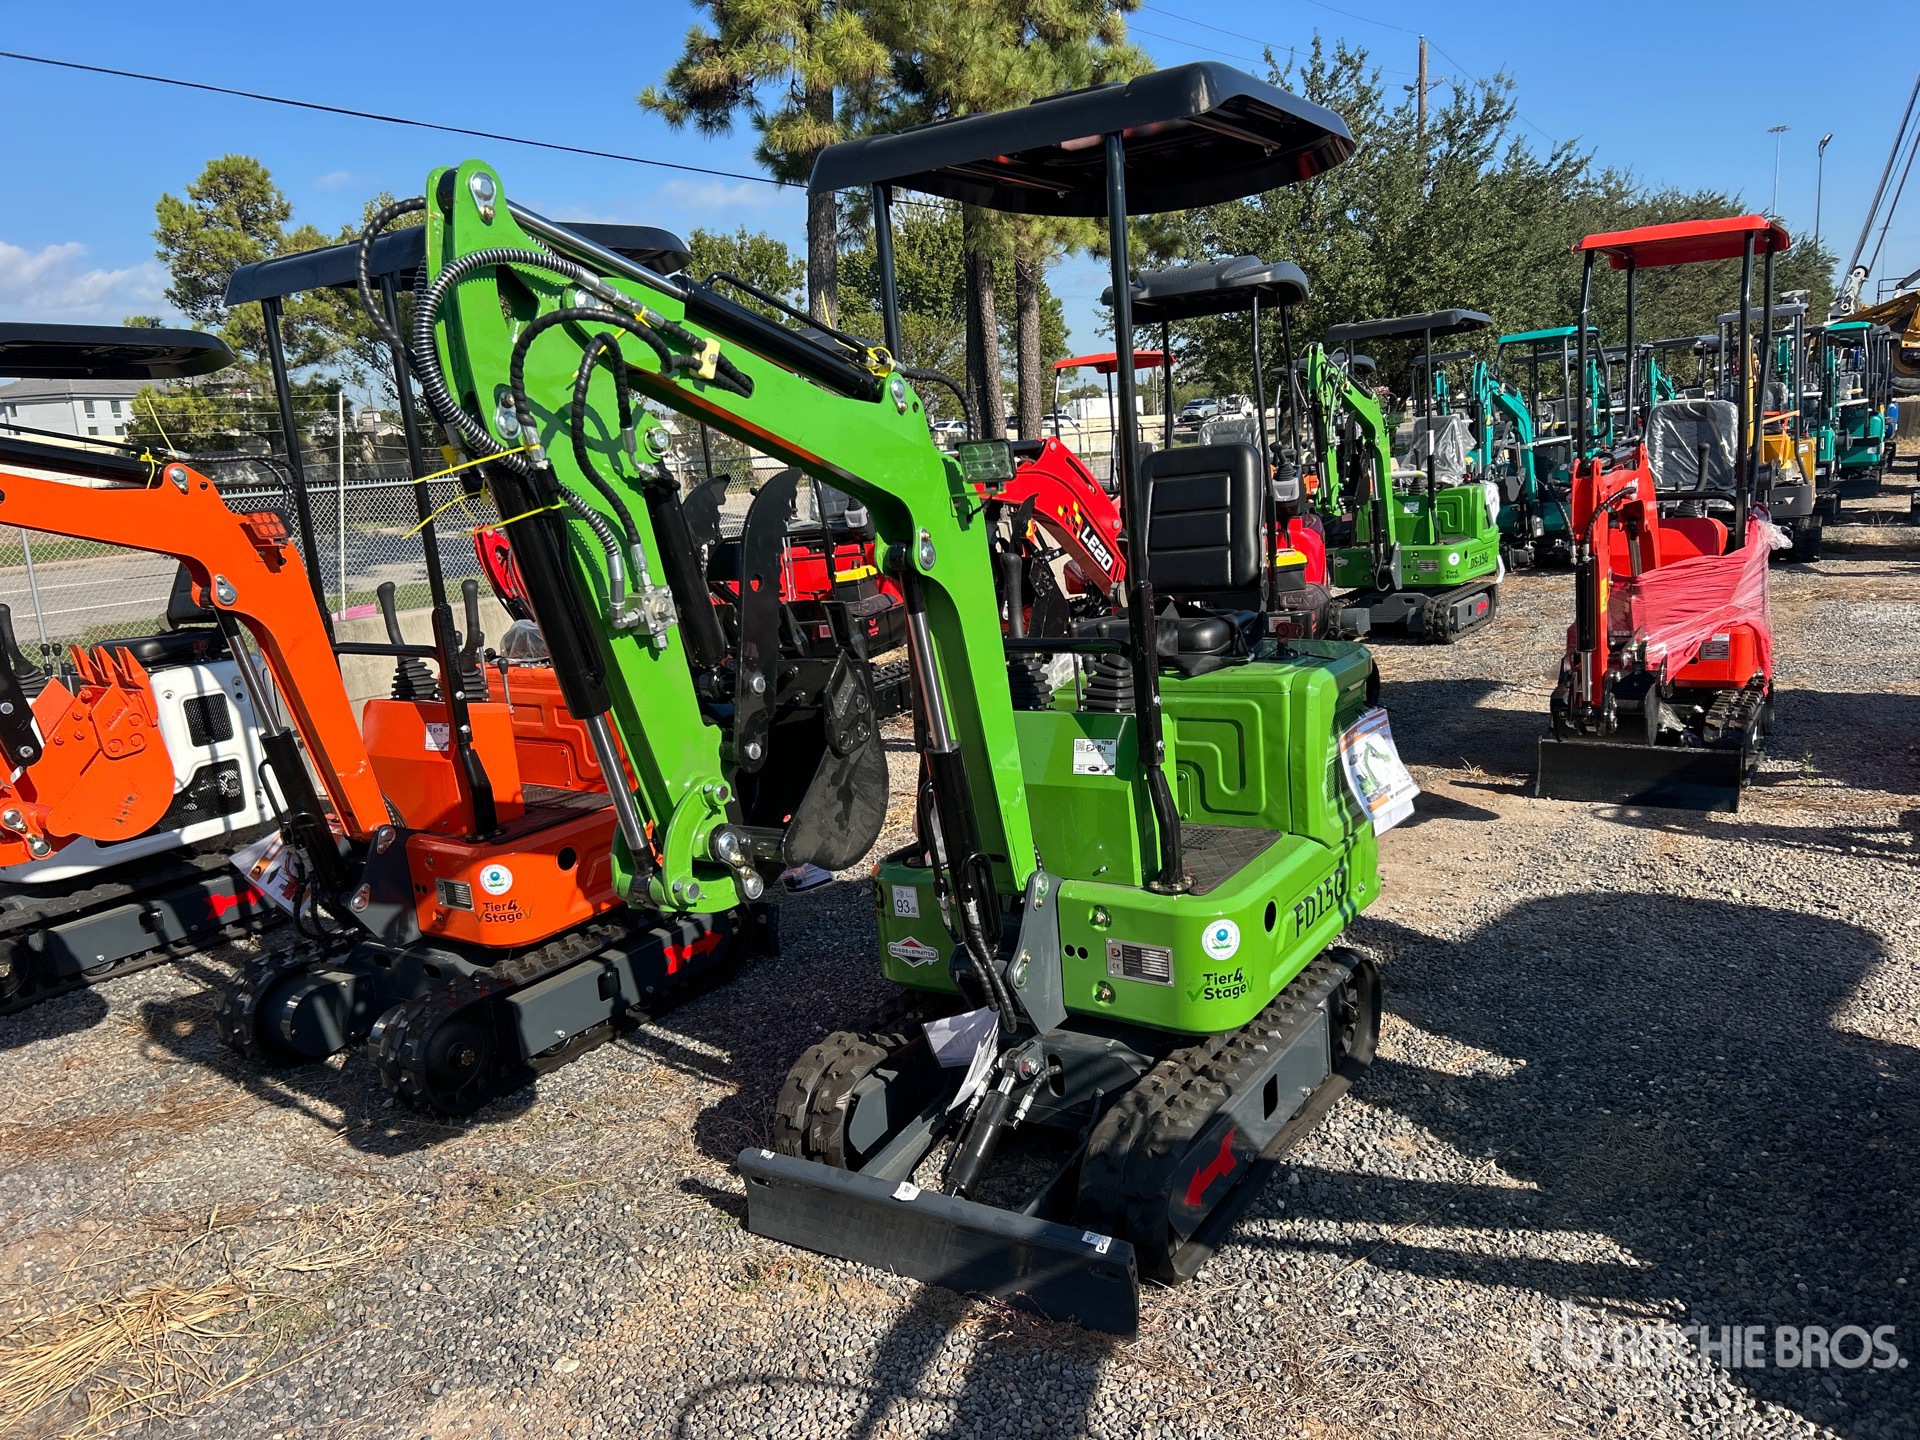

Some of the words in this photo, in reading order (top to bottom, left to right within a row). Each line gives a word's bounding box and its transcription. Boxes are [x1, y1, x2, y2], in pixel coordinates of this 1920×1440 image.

[1081, 526, 1113, 571] LE20
[896, 899, 911, 914] 93
[1294, 867, 1347, 938] FD15G
[484, 911, 523, 924] Stage
[1203, 983, 1247, 1000] Stage
